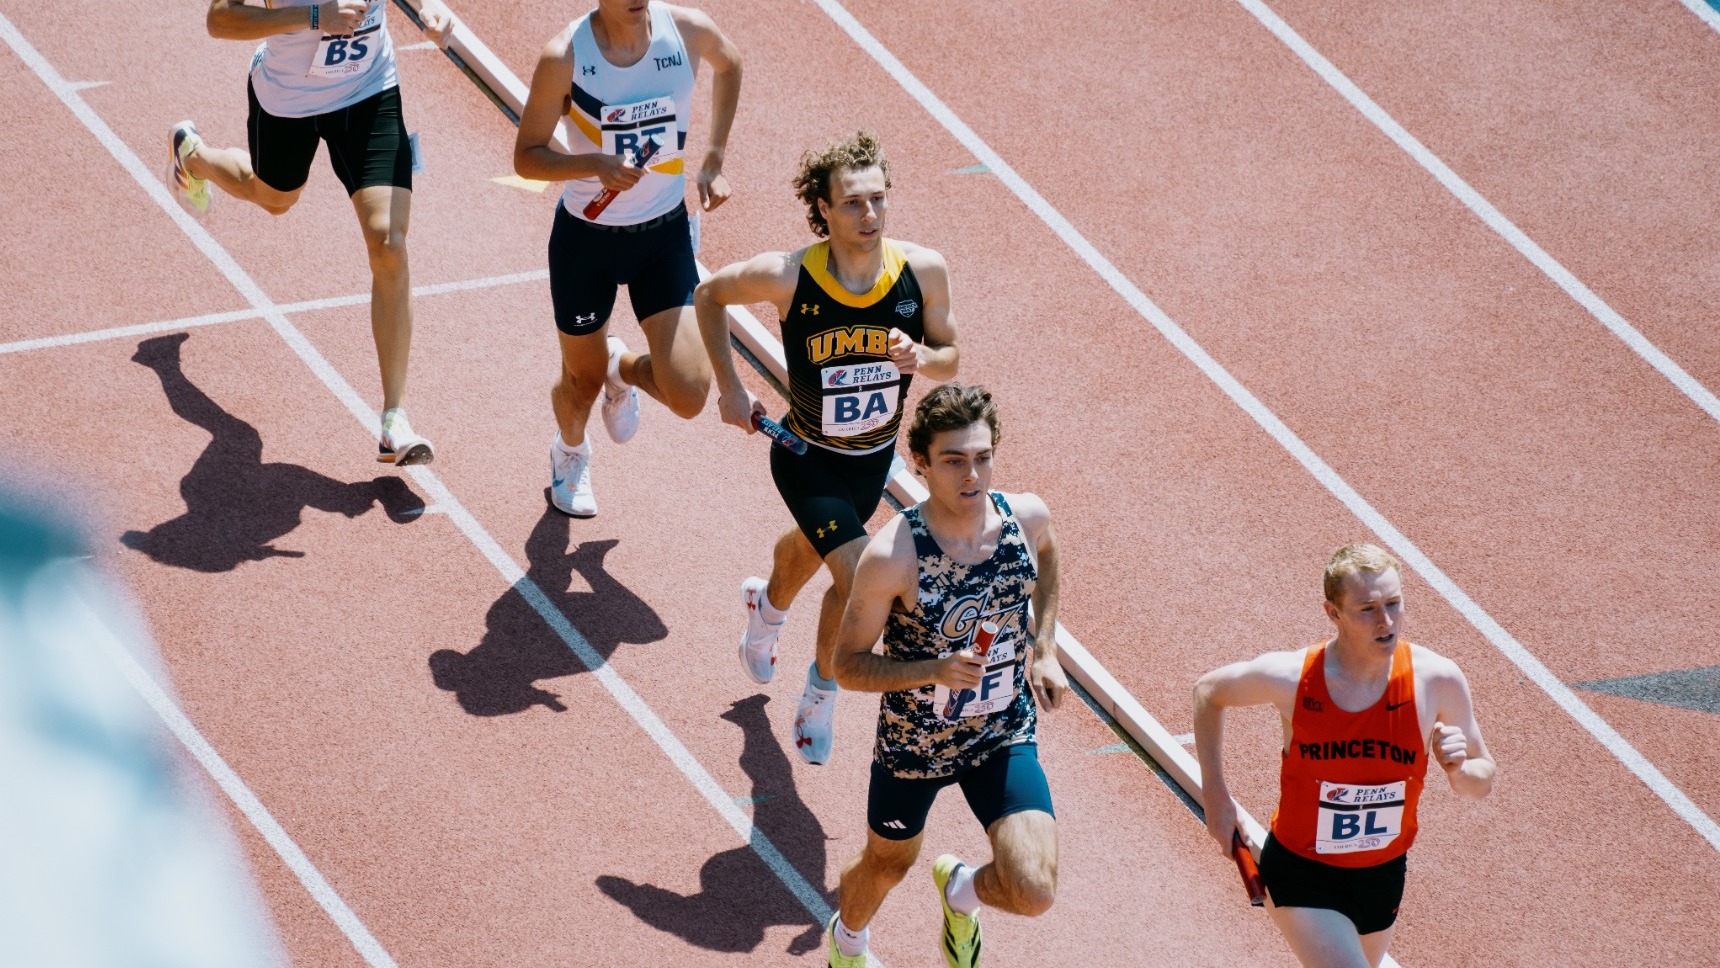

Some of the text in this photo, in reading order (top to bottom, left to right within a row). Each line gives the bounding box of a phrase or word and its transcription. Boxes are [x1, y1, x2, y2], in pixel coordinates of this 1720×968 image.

[324, 36, 370, 66] BS
[653, 51, 683, 71] TCNJ
[631, 107, 667, 121] RELAYS
[632, 101, 659, 114] PENN
[806, 324, 893, 365] UMB
[853, 372, 892, 384] RELAYS
[854, 365, 882, 376] PENN
[834, 391, 888, 423] BA
[1299, 739, 1417, 765] PRINCETON
[1353, 791, 1396, 802] RELAYS
[1356, 787, 1387, 796] PENN
[1331, 811, 1387, 840] BL
